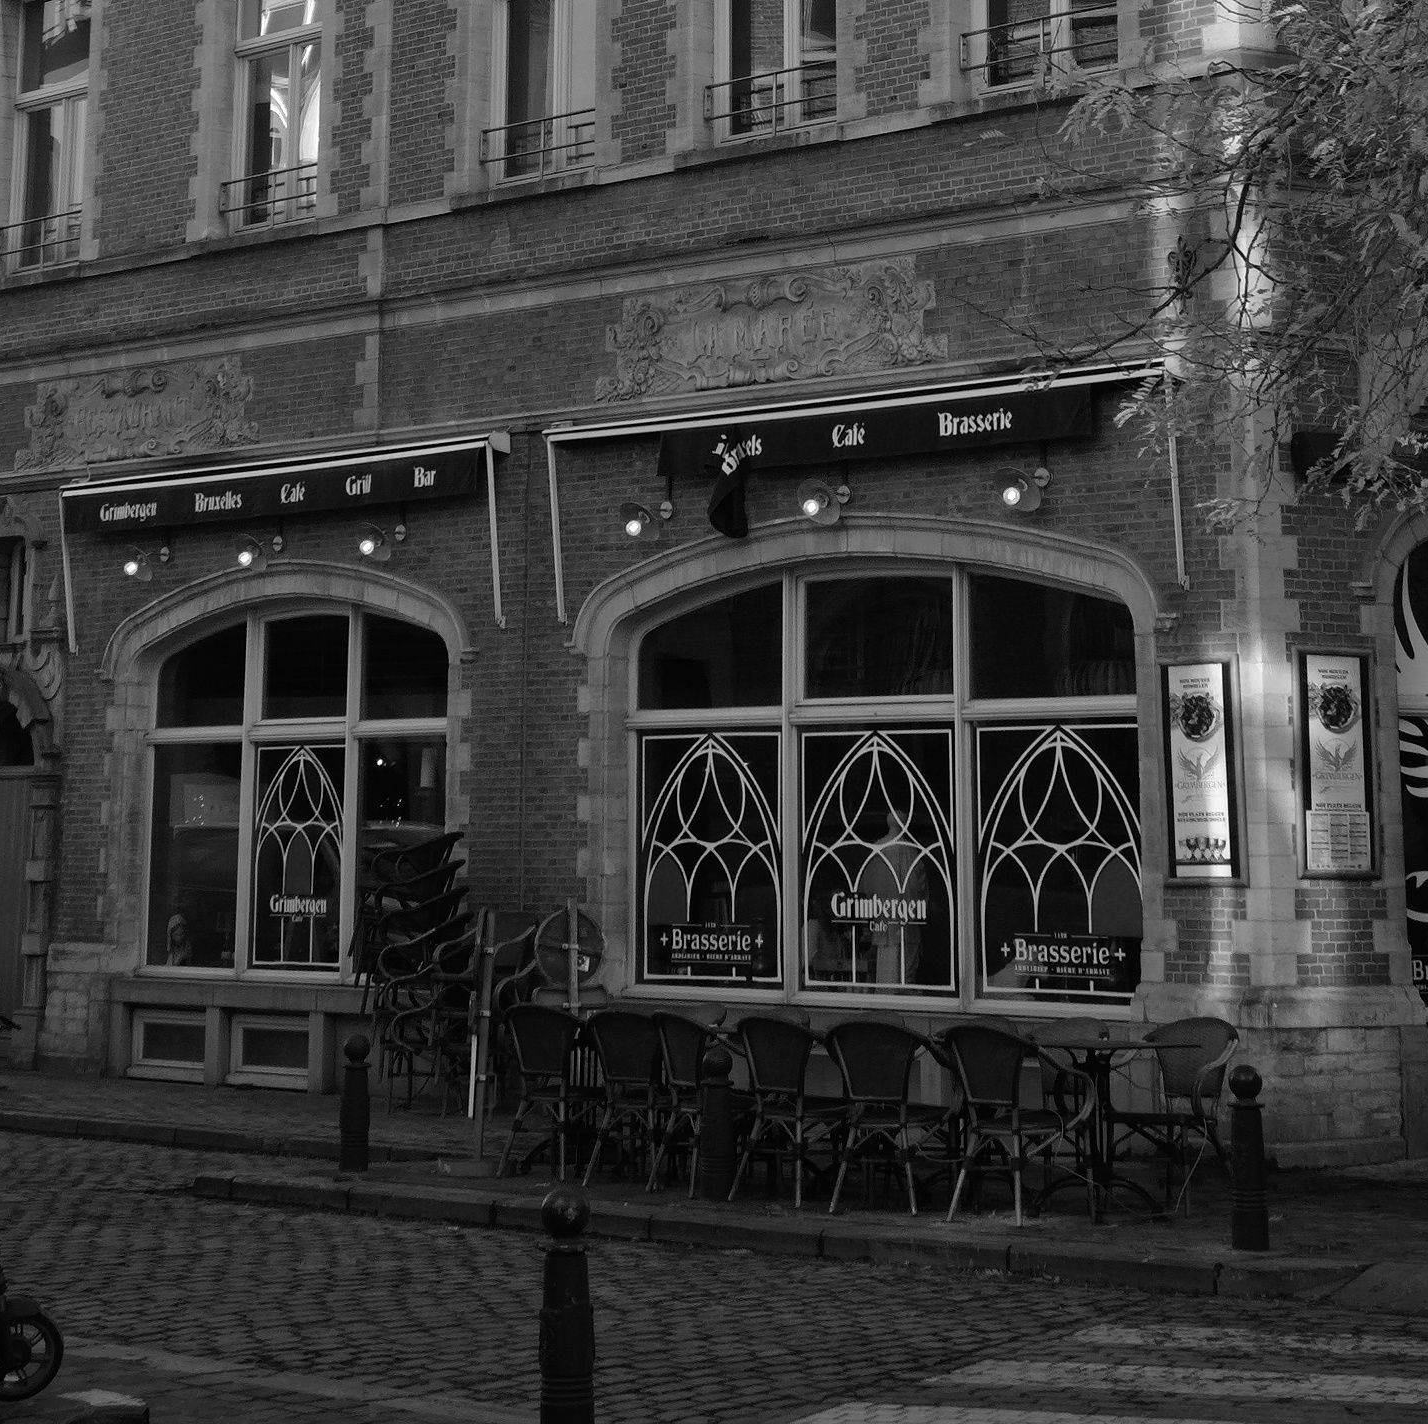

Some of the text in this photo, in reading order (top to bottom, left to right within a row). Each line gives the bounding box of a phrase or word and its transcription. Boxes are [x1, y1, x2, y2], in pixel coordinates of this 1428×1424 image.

[831, 422, 866, 448] Café
[937, 408, 1013, 437] Brasserie
[99, 466, 437, 523] Grimbergen Bruxelles Café Grill Bar
[269, 893, 327, 917] Grimbergen
[831, 891, 927, 926] Grimbergen
[672, 928, 751, 952] Brasserie
[1014, 938, 1110, 966] Brasserie
